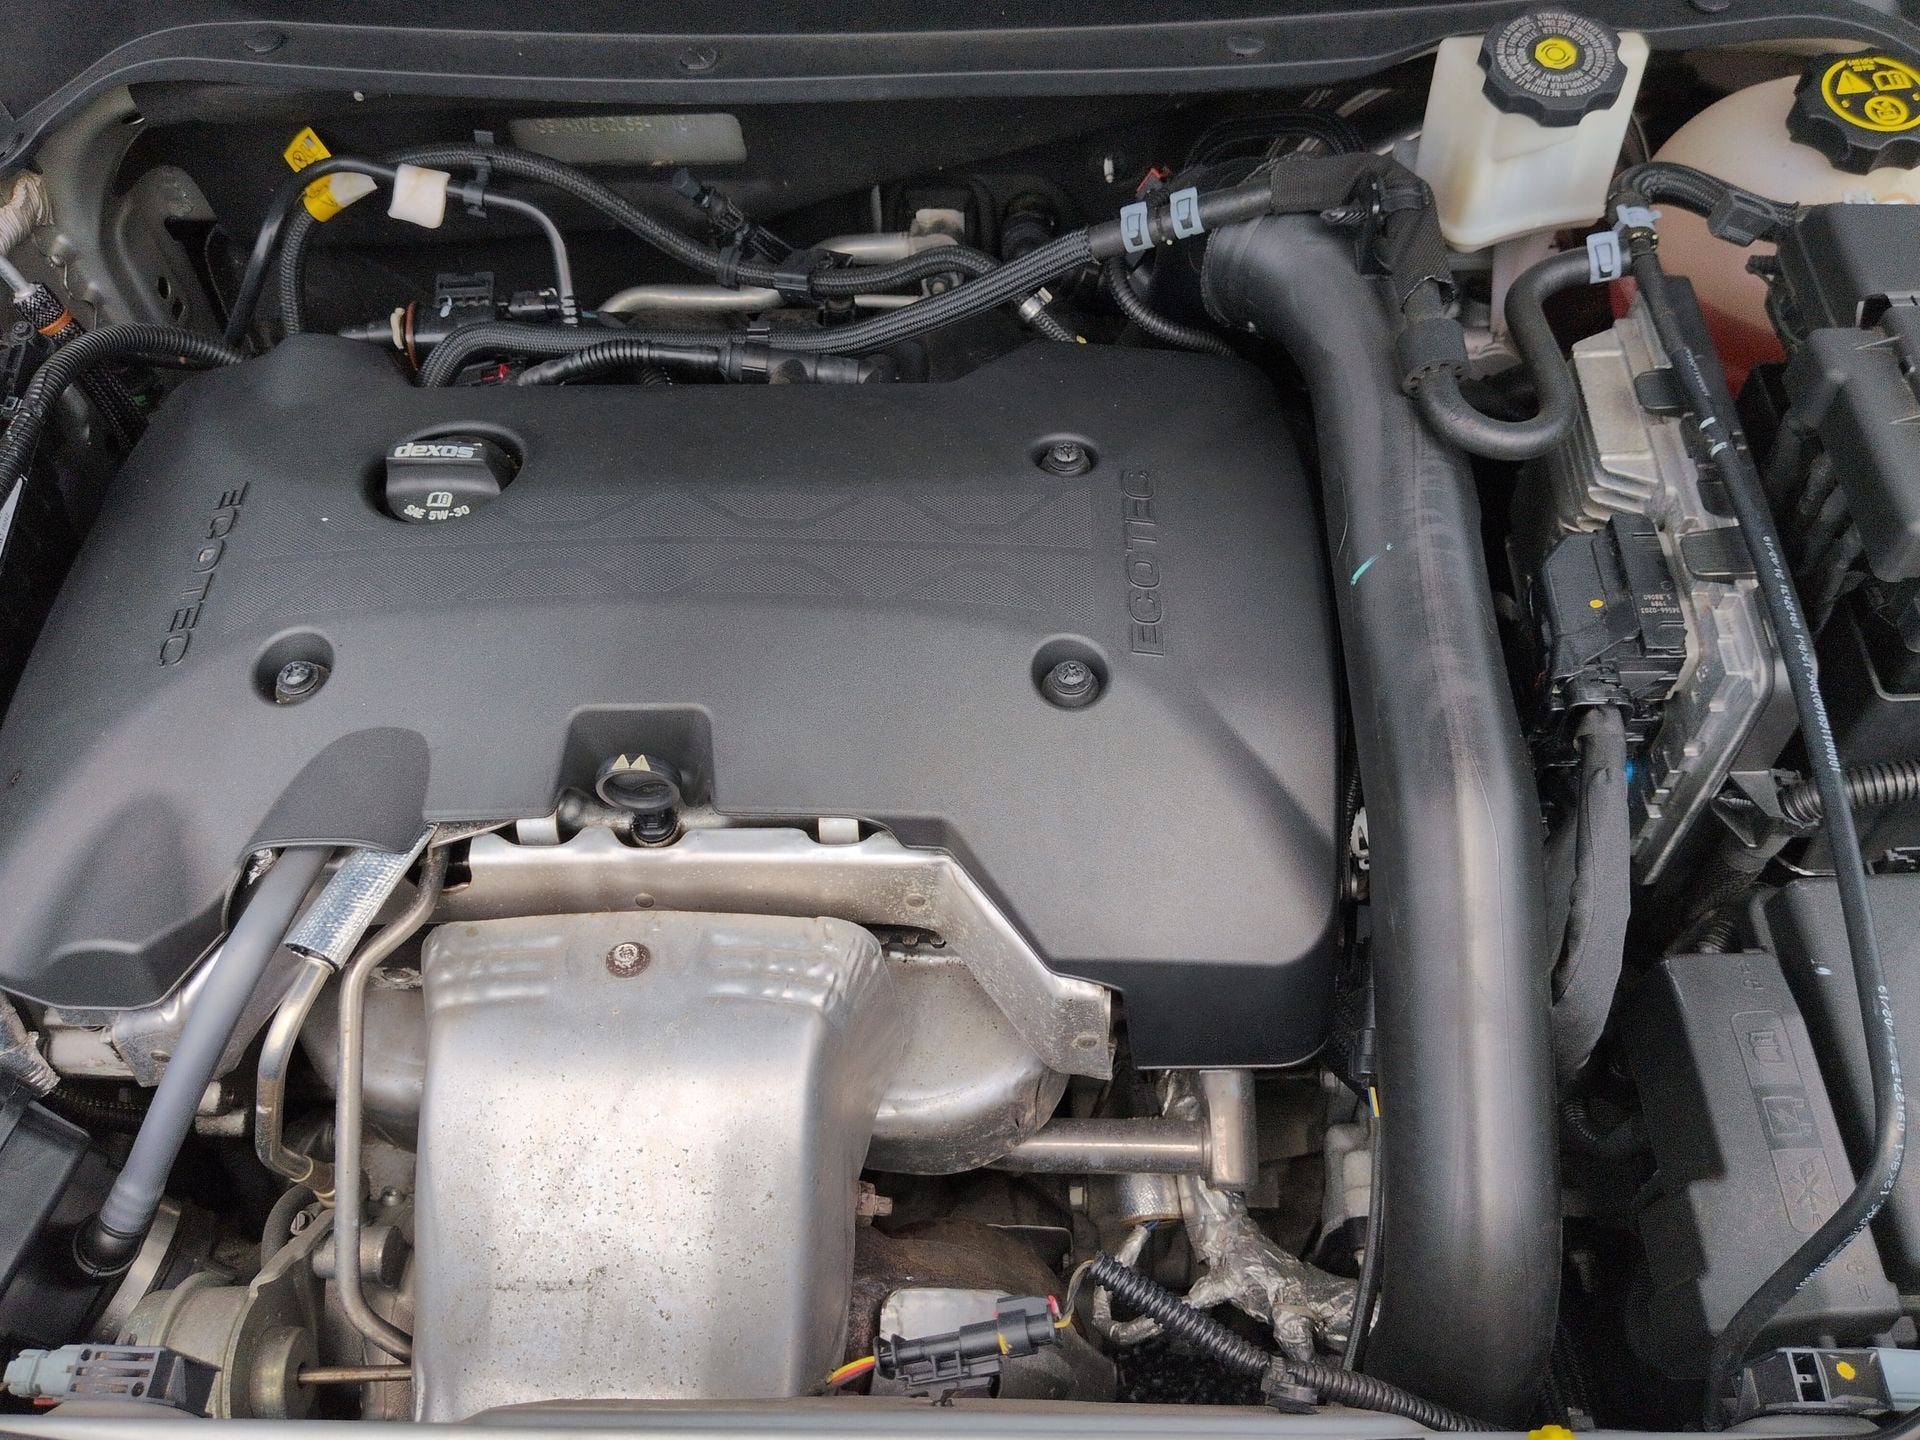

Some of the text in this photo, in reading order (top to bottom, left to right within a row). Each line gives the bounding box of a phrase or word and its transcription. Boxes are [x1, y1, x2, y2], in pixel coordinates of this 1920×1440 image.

[1541, 26, 1568, 34] FILLER
[1522, 81, 1561, 97] NETTOYER
[394, 442, 475, 458] dexos
[403, 504, 470, 521] SAE 5W-30
[1121, 470, 1165, 657] ECOTEC
[158, 481, 250, 668] ECOTEC
